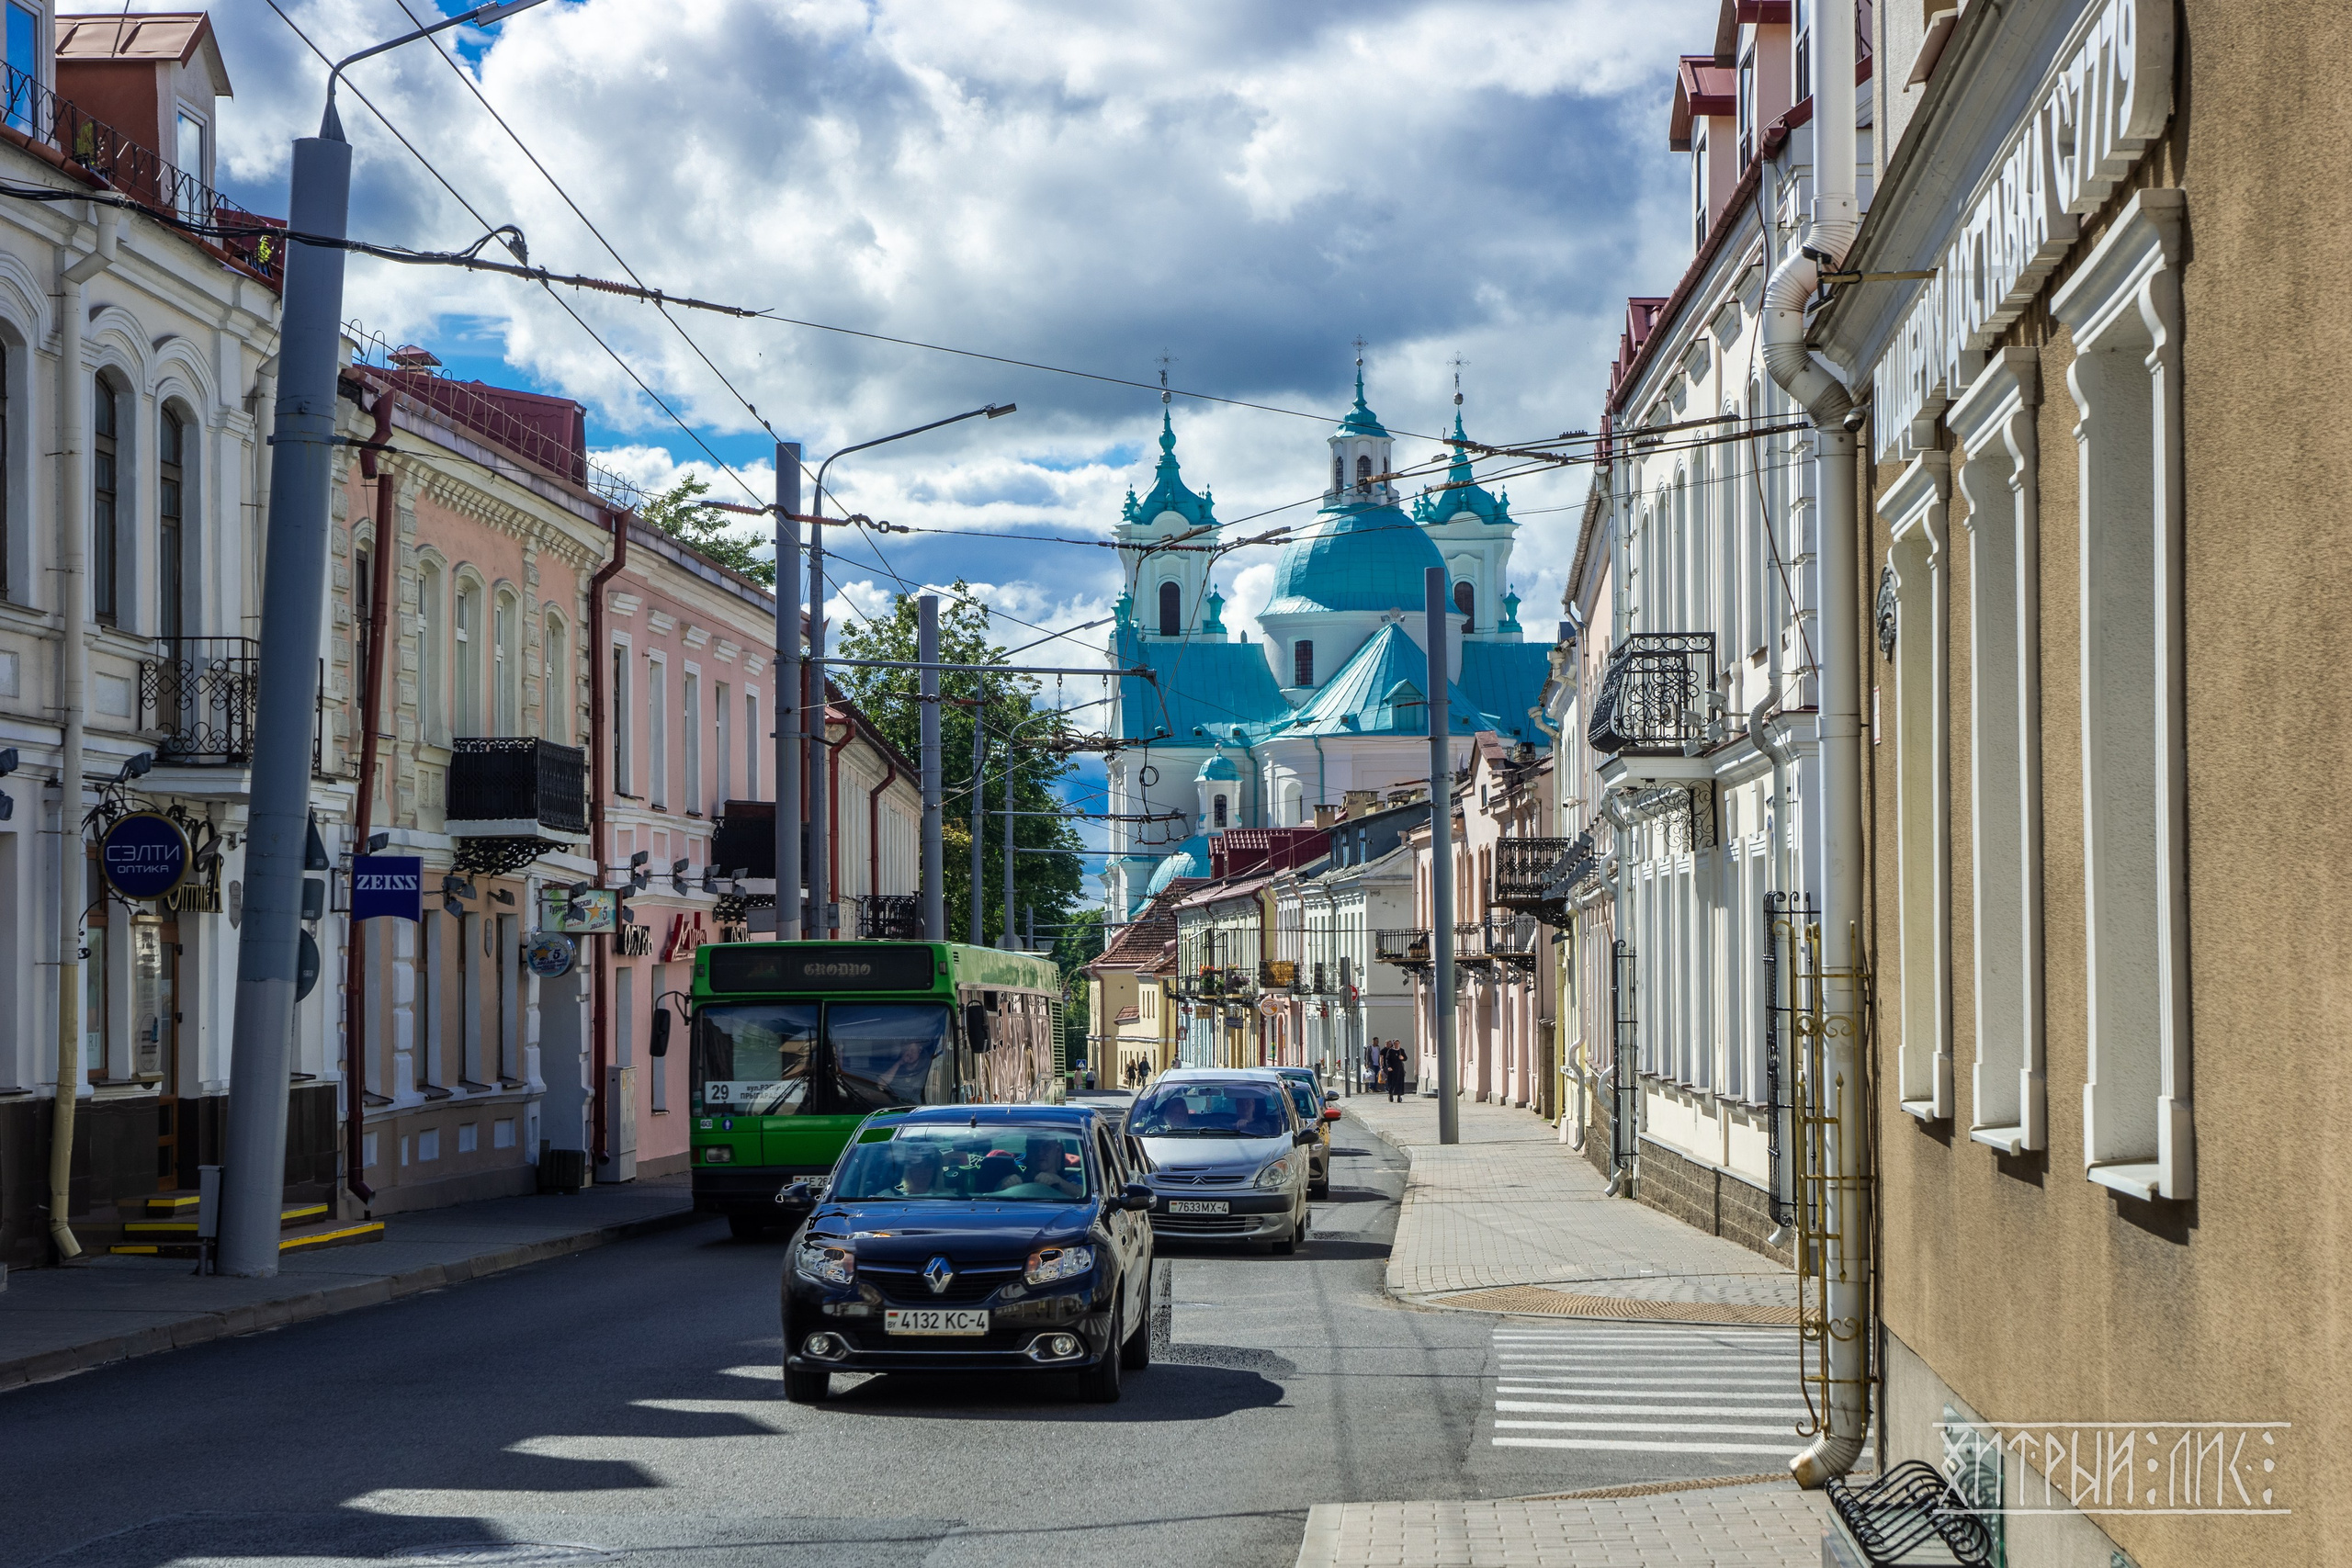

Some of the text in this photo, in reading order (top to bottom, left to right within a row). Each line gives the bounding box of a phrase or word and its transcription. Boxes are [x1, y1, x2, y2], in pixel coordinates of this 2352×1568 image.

[1946, 109, 2049, 400] ДОСТАВКА
[107, 844, 180, 862] СЭЛТИ
[117, 864, 169, 874] ОПТИКА
[356, 874, 417, 890] ZEISS
[625, 924, 653, 955] ОБУВЬ
[711, 1084, 729, 1100] 29
[901, 1312, 939, 1329] 4132
[945, 1312, 986, 1329] KC-4
